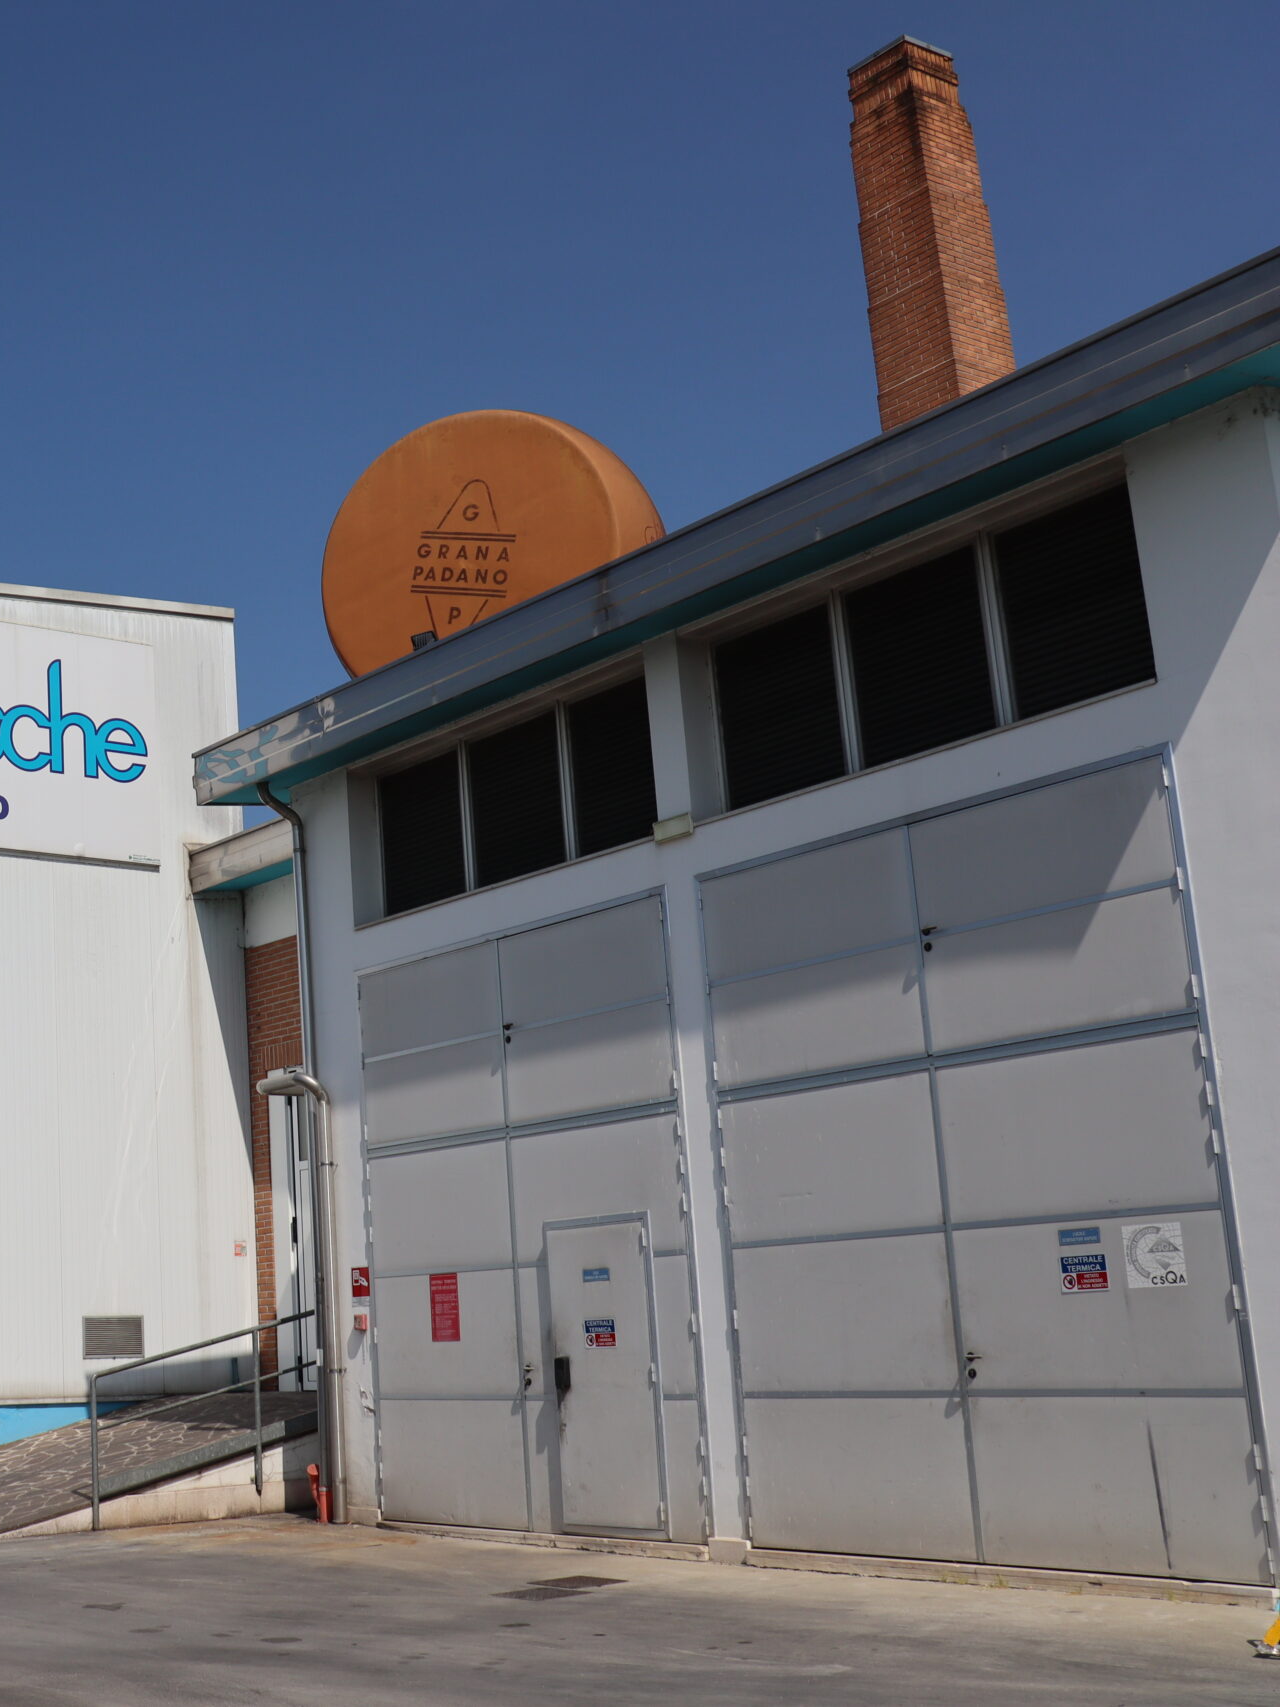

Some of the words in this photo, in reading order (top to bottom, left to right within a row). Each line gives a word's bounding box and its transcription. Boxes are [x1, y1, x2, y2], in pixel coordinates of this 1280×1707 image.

[462, 504, 480, 522] G
[417, 543, 510, 563] GRANA
[412, 565, 508, 585] PADANO
[447, 606, 462, 625] P
[1062, 1255, 1103, 1265] CENTRALE
[1066, 1264, 1102, 1273] TERMICA
[1151, 1270, 1186, 1285] CSQA
